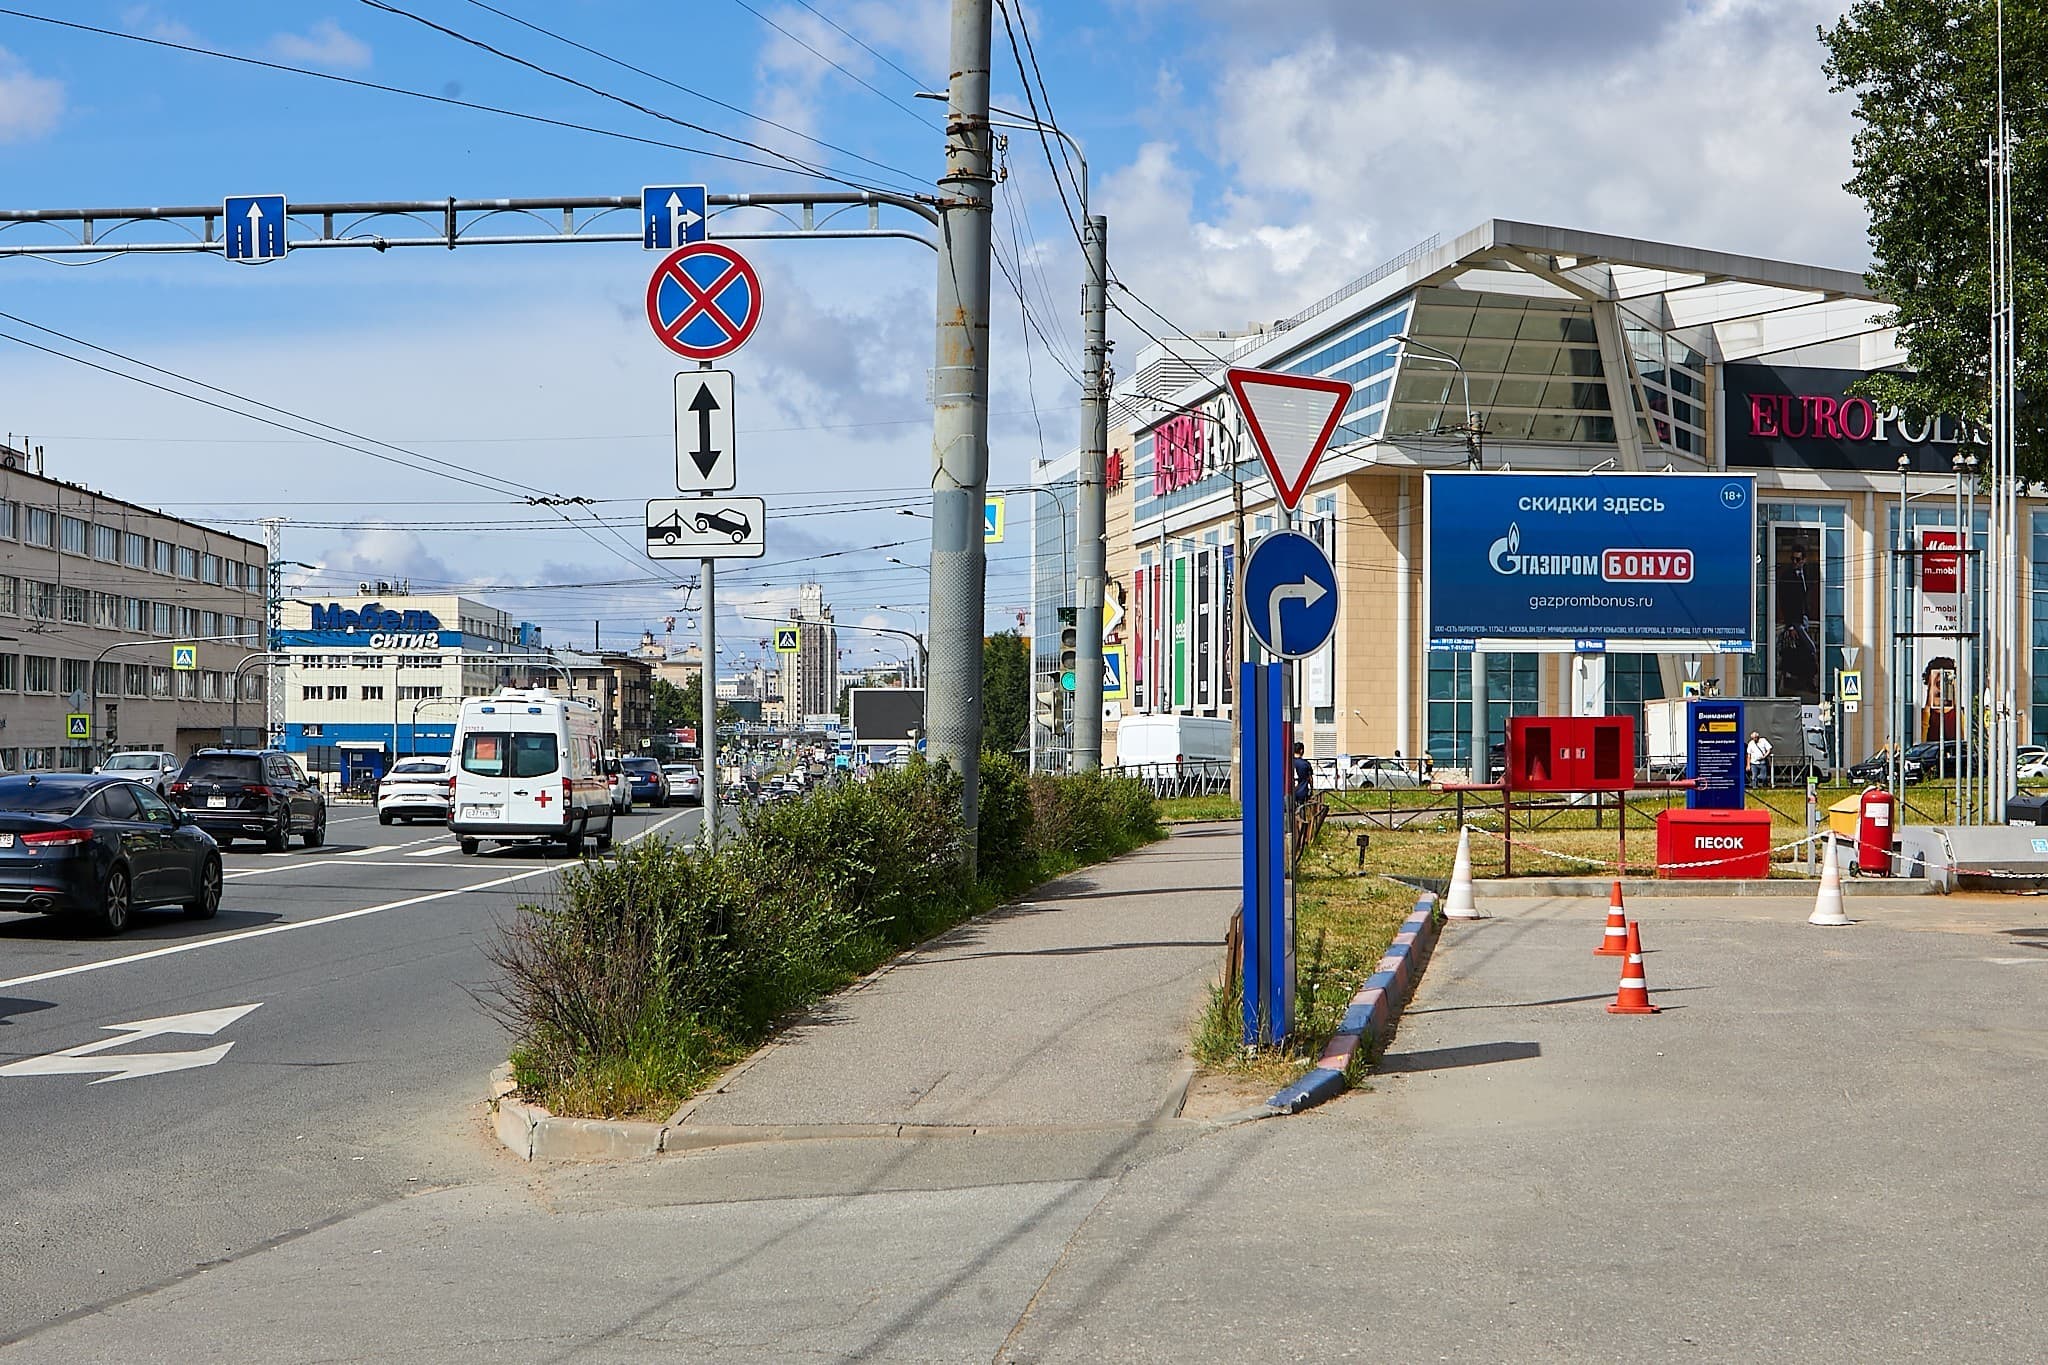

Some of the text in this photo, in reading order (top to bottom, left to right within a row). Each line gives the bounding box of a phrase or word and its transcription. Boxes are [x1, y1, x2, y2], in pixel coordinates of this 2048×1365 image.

[1723, 489, 1743, 502] 18+
[1518, 496, 1665, 514] СКИДКИ ЗДЕСЬ
[1521, 555, 1687, 576] ГАЗПРОМ БОНУС
[1529, 595, 1653, 610] gazprombonus.ru
[311, 602, 440, 630] Мебель
[1698, 712, 1736, 720] Внимание!
[1695, 836, 1744, 850] ПЕСОК
